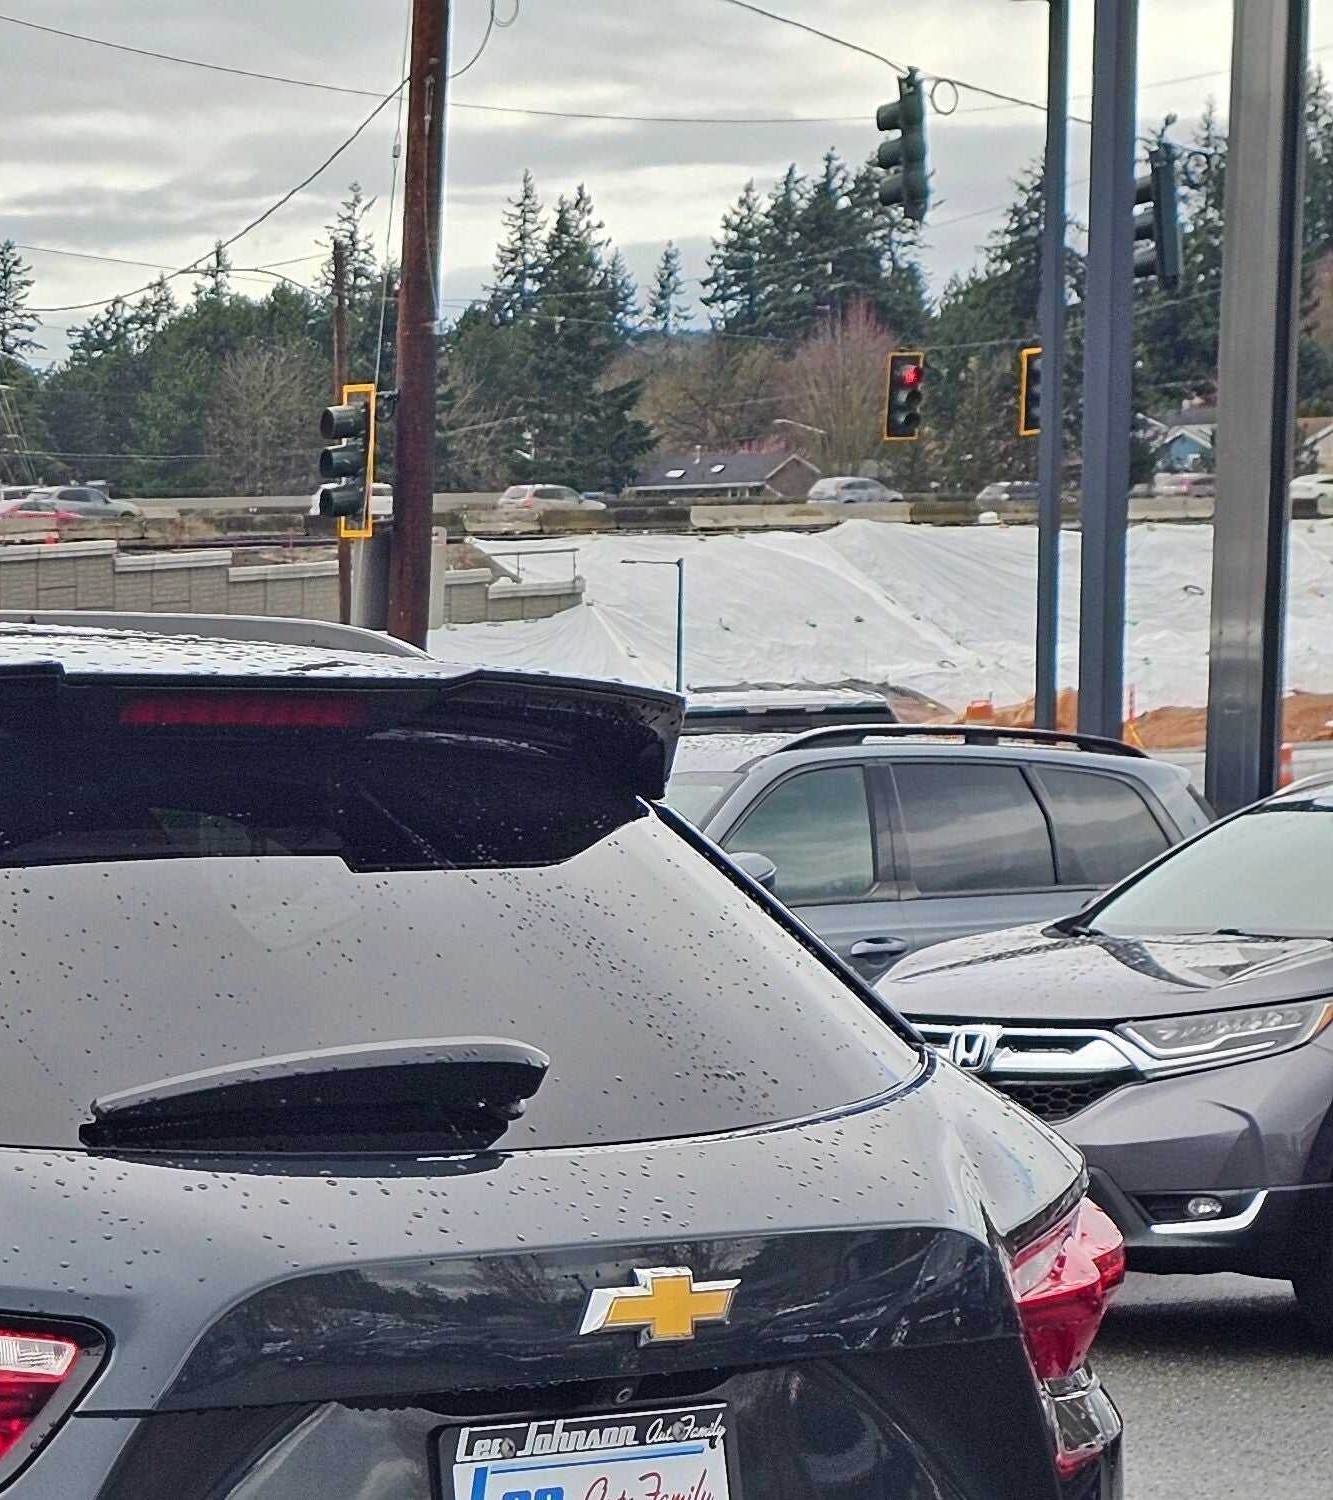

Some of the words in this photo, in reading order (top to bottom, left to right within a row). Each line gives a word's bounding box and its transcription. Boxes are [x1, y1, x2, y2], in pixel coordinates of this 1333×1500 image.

[516, 1419, 640, 1457] Johnson
[646, 1418, 679, 1443] Aut
[680, 1412, 726, 1446] Family
